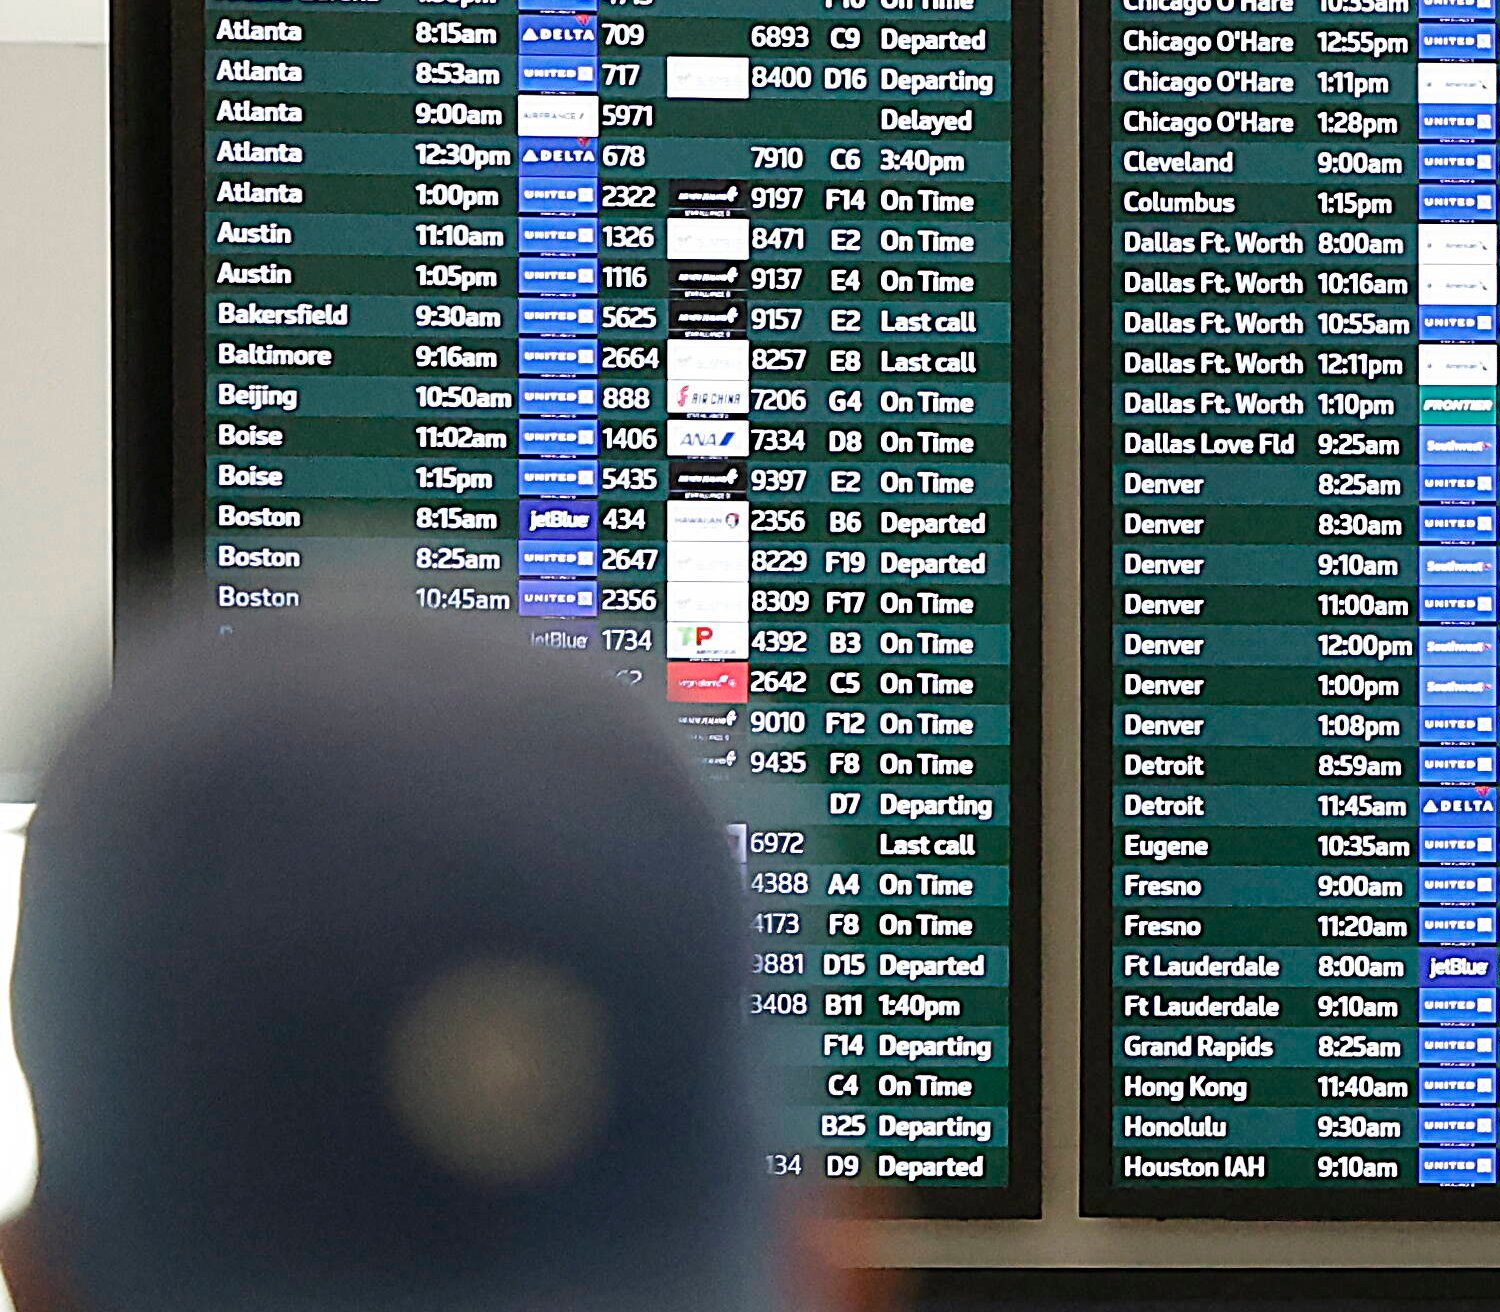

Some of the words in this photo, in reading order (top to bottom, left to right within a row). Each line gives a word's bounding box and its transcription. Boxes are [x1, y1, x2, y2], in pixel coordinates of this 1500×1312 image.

[1123, 150, 1234, 173] Cleveland
[1317, 151, 1403, 174] 9:00am
[1423, 157, 1479, 167] UNITED
[218, 504, 301, 527] Boston
[416, 507, 498, 530] 8:15am
[528, 510, 590, 532] jetBlue
[602, 507, 646, 530] 434
[750, 509, 806, 532] 2356
[829, 511, 862, 533] B6
[880, 511, 986, 539] Departed
[878, 994, 961, 1020] 1:40pm
